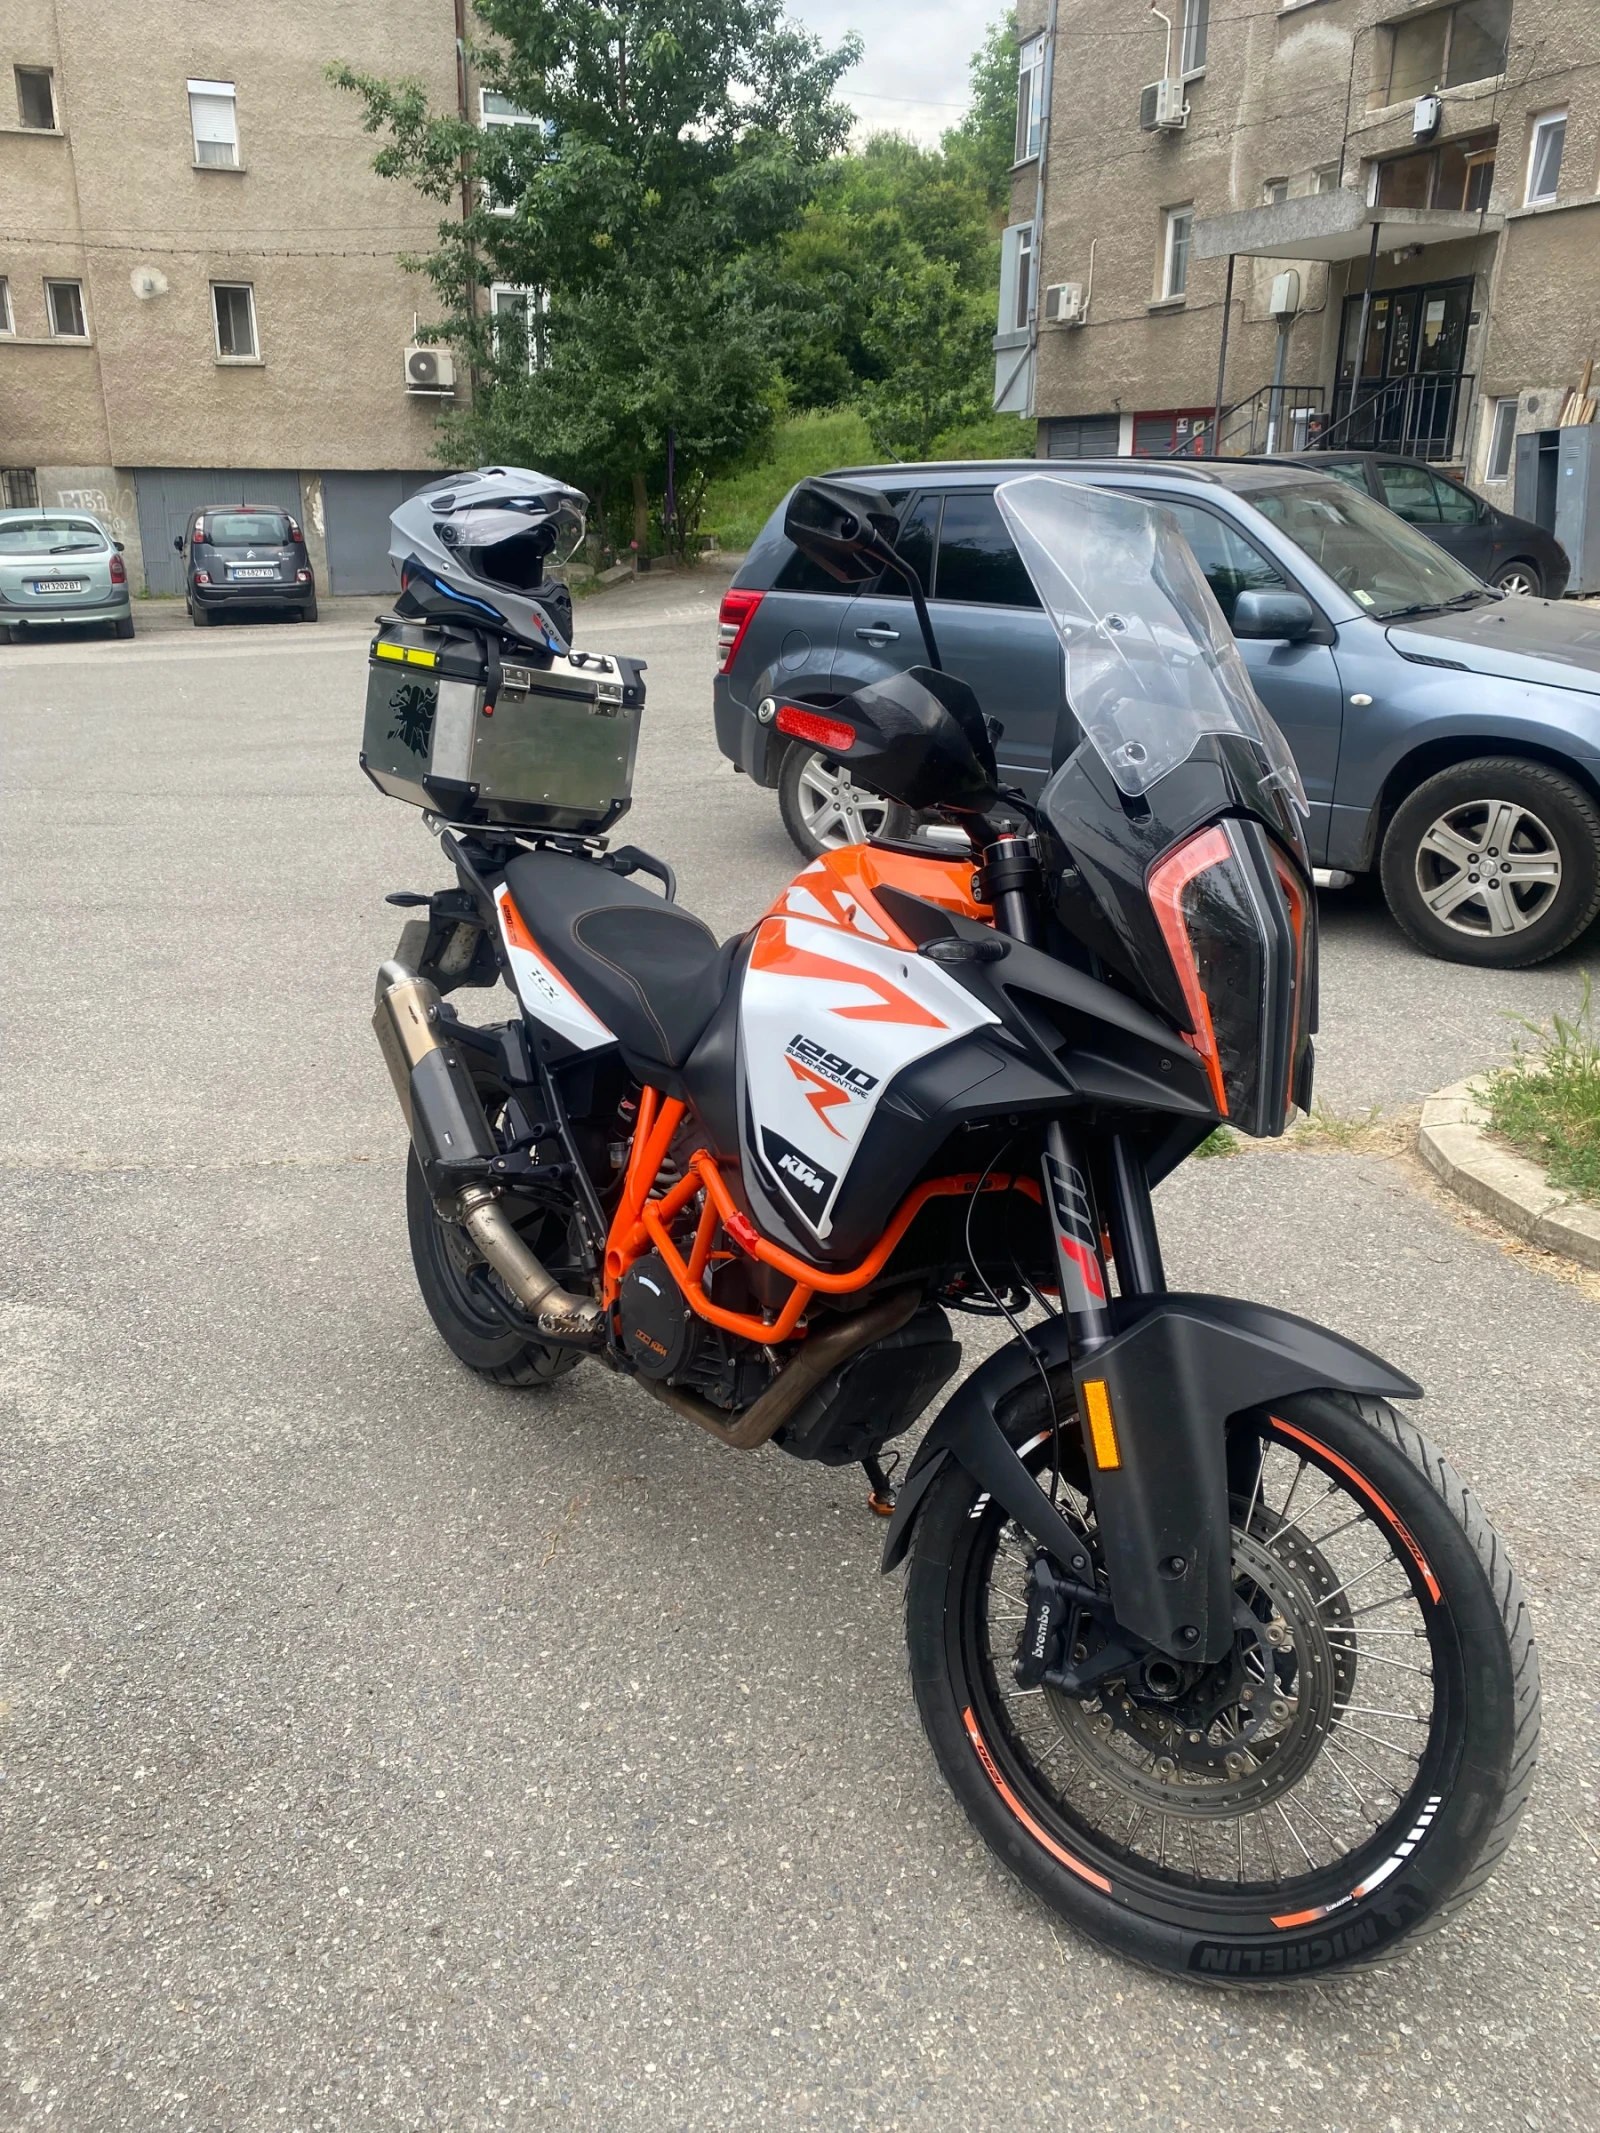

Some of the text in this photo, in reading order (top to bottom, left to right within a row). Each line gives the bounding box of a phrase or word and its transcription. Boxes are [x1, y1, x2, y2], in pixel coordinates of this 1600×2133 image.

[51, 582, 69, 590] 3202
[536, 612, 560, 642] AIROH
[785, 1046, 870, 1099] SUPER-ADVENTURE
[789, 1033, 880, 1091] 1290
[778, 1153, 825, 1194] KTM
[1392, 1520, 1424, 1562] 1290
[1032, 1605, 1050, 1658] brembo
[977, 1745, 1002, 1785] 1290
[1199, 1917, 1380, 1972] MICHELIN
